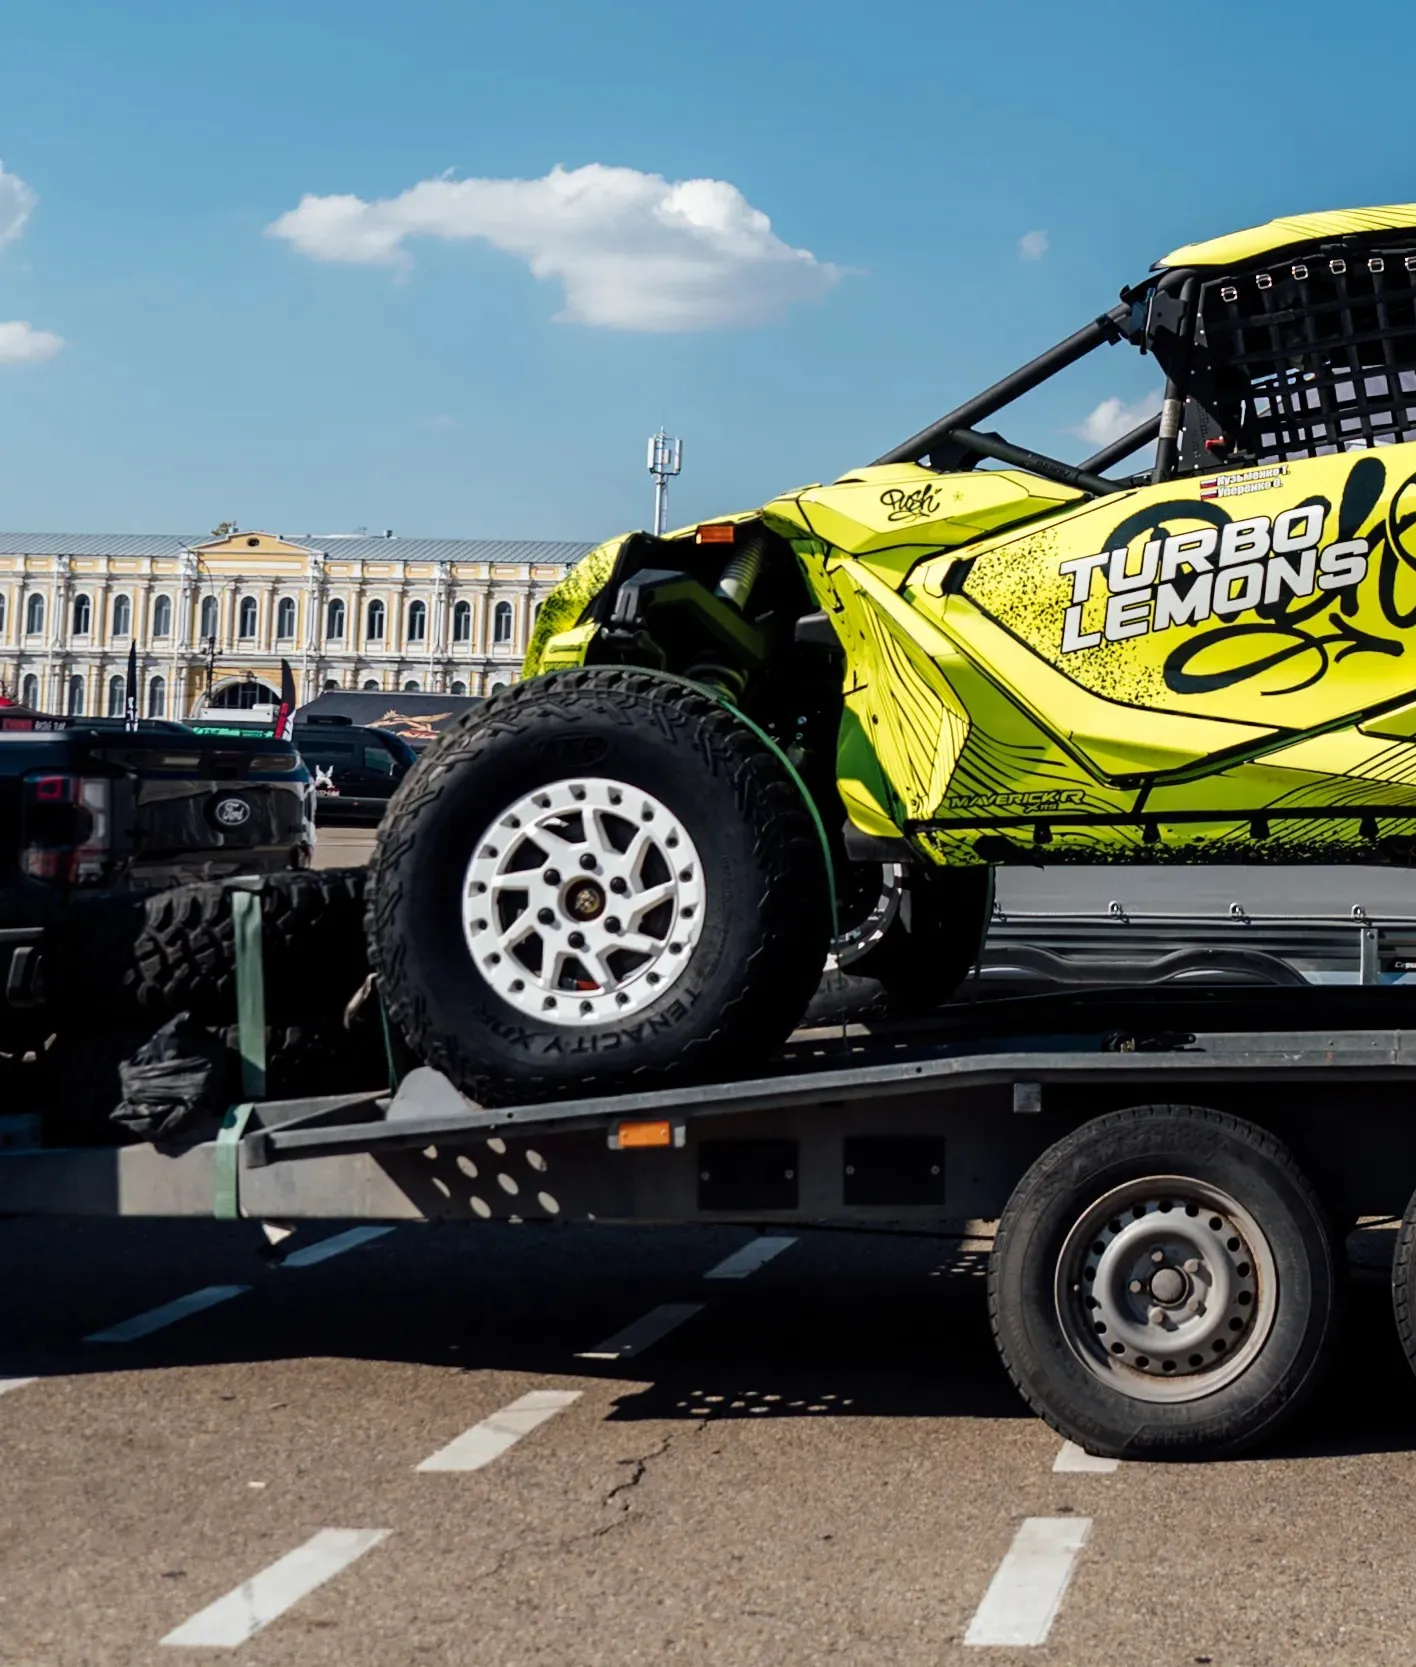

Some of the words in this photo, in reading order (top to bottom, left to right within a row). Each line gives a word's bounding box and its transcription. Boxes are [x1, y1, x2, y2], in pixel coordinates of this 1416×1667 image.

[1217, 468, 1280, 486] Кузьменко
[1218, 481, 1272, 497] Уперенко
[1060, 504, 1326, 602] TURBO
[1060, 537, 1369, 655] LEMONS
[950, 791, 1059, 808] MAVERICK
[1060, 789, 1085, 804] R
[222, 802, 245, 821] Ford
[541, 987, 704, 1056] TENACITY
